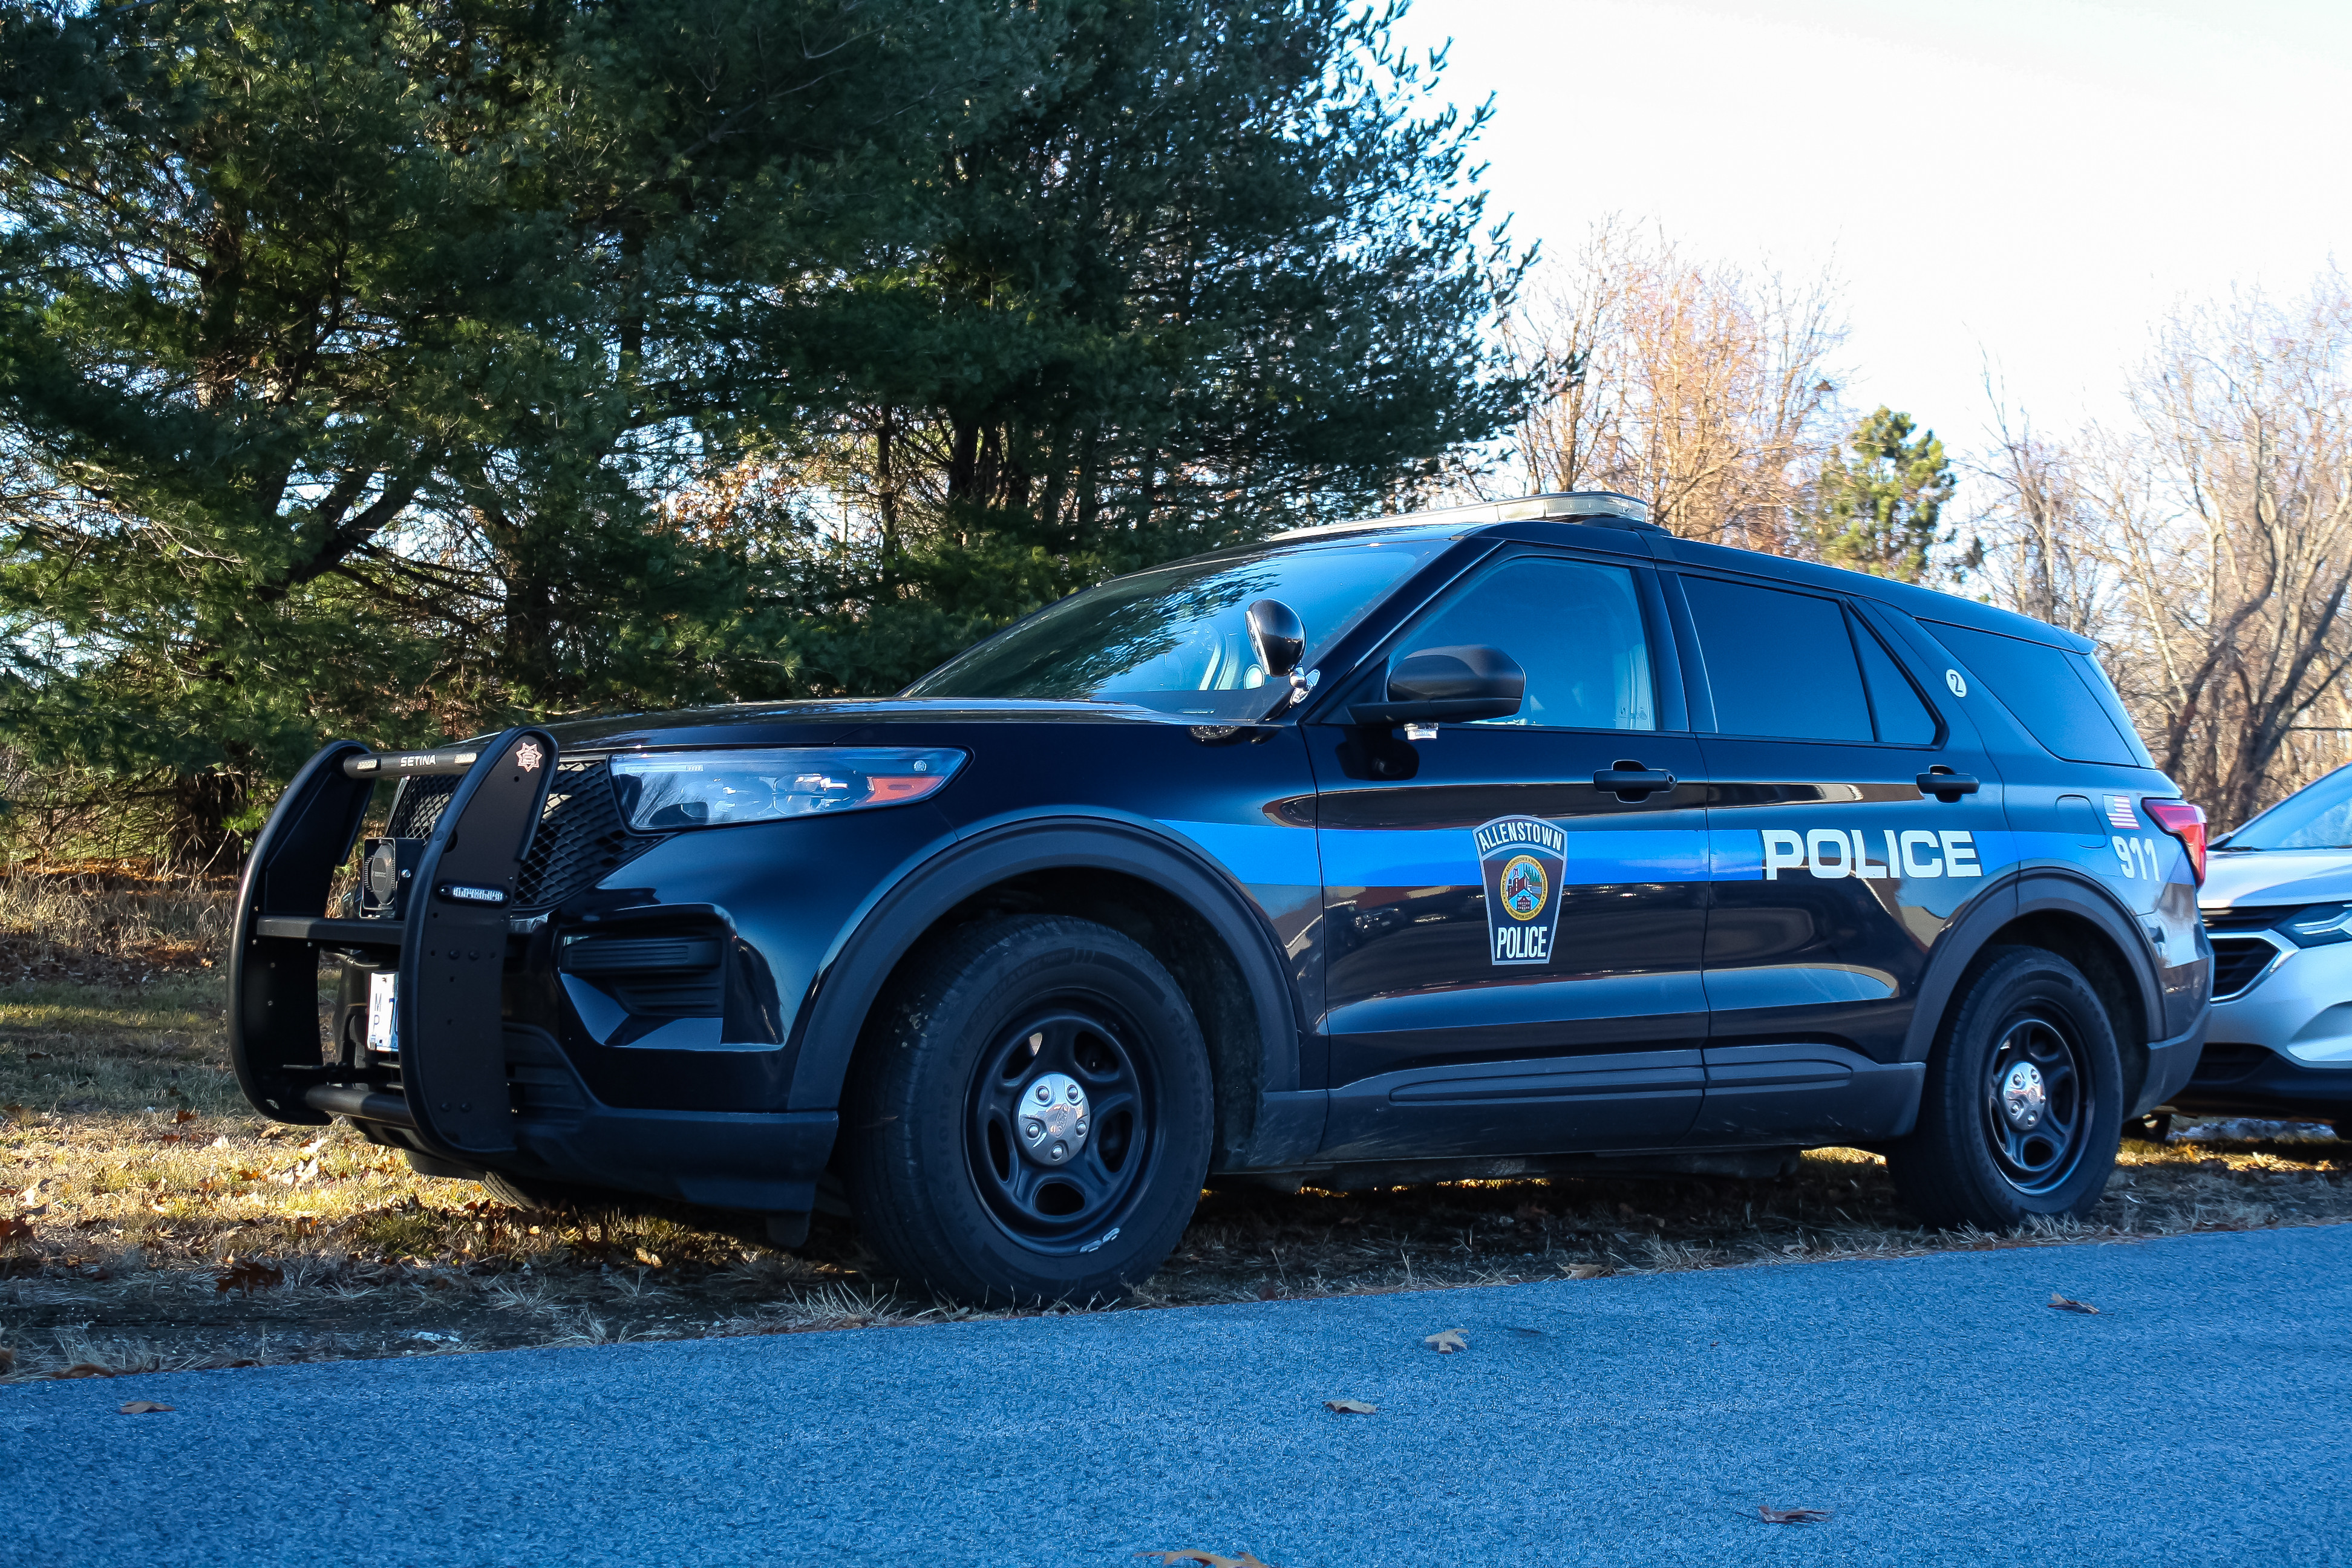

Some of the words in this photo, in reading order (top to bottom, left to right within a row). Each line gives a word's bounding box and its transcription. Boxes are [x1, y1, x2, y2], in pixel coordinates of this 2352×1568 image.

[1950, 673, 1964, 693] 2
[400, 754, 436, 767] SETINA
[1478, 822, 1562, 852] ALLENSTOWN
[1761, 829, 1982, 880] POLICE
[2111, 835, 2161, 882] 911
[1497, 926, 1547, 959] POLICE
